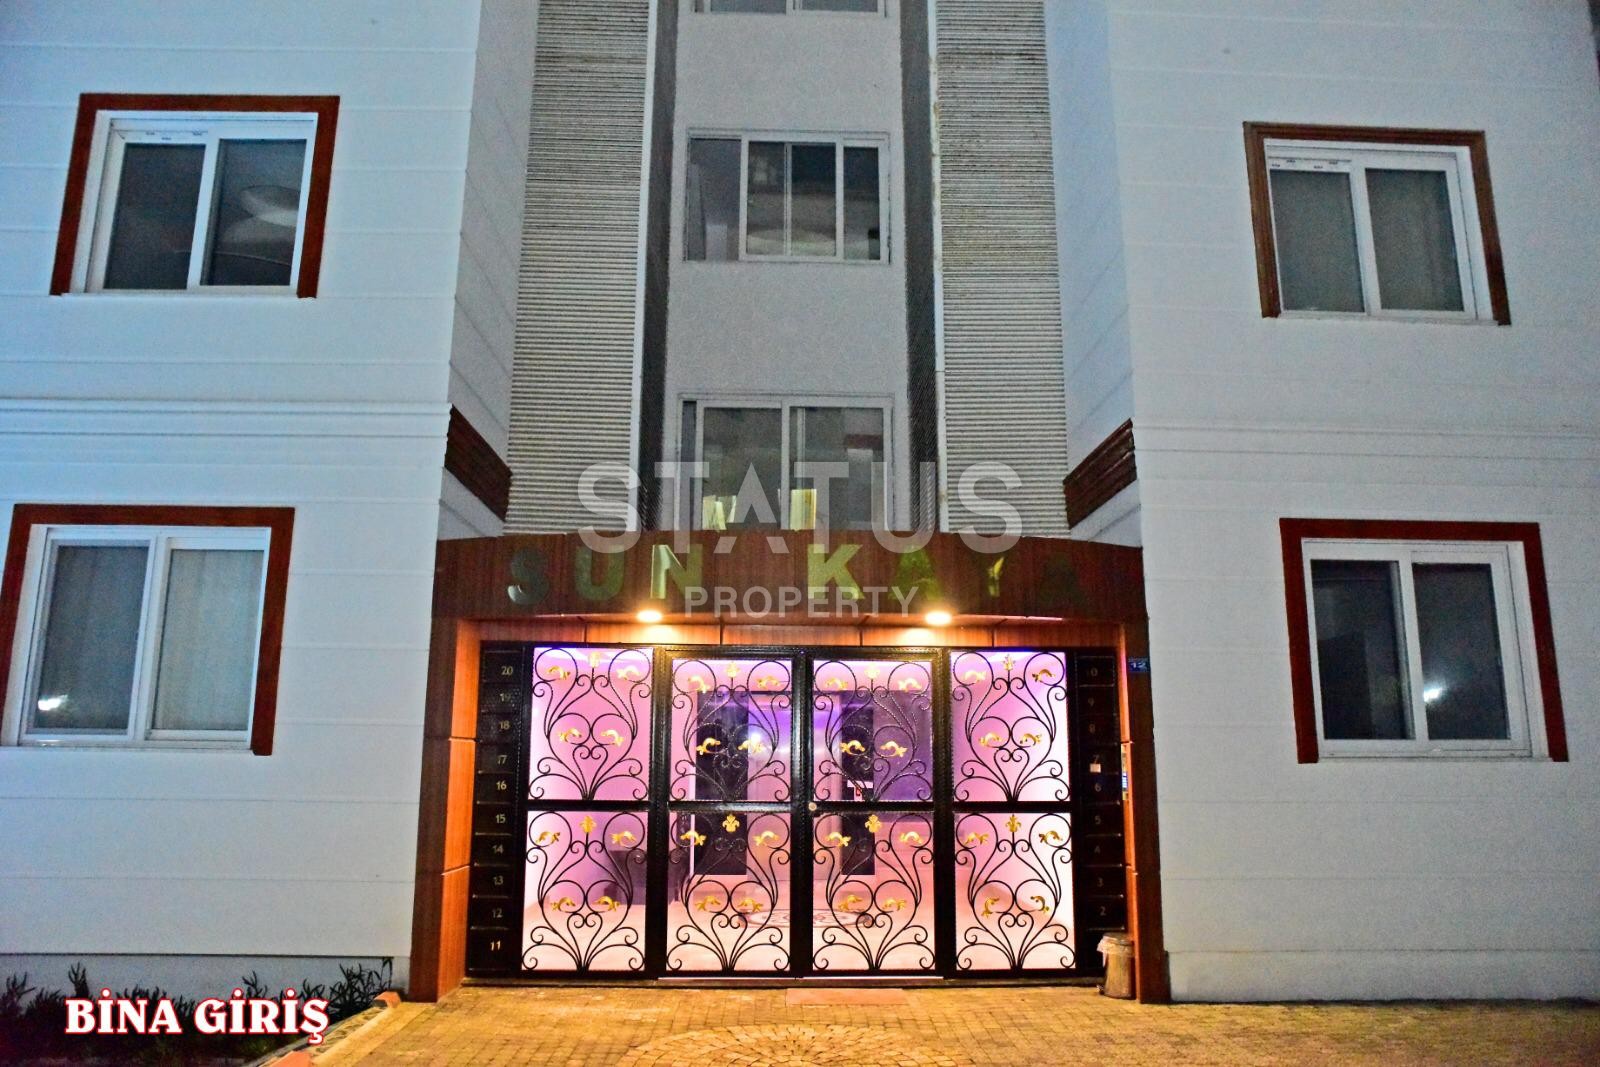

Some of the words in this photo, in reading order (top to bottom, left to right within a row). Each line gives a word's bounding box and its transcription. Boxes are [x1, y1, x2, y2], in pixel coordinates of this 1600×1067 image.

[507, 545, 703, 605] SUN
[501, 665, 514, 676] 20
[499, 720, 511, 731] 18
[497, 754, 508, 765] 17
[495, 780, 508, 791] 16
[495, 813, 506, 824] 15
[492, 844, 504, 854] 14
[493, 875, 504, 886] 13
[492, 908, 503, 919] 12
[1099, 906, 1107, 917] 2
[489, 940, 502, 951] 11
